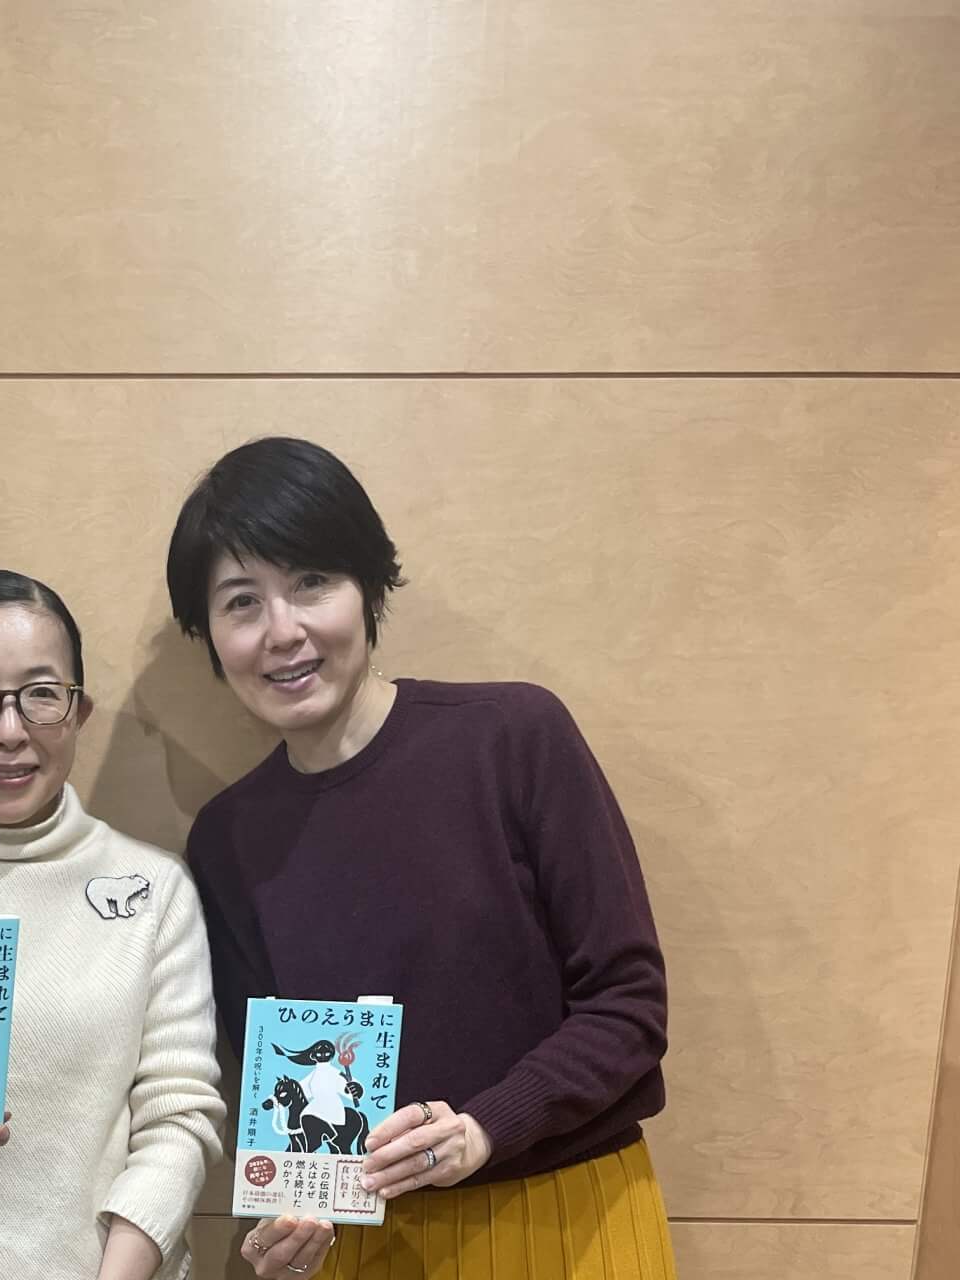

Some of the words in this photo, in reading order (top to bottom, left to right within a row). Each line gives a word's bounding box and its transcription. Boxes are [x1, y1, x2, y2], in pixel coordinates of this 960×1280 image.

[278, 1007, 394, 1027] ひのえうまに
[371, 1032, 394, 1110] 生まれて
[293, 1160, 305, 1208] 燃え続けた
[306, 1161, 318, 1199] 火はなぜ
[318, 1161, 330, 1209] この伝説の
